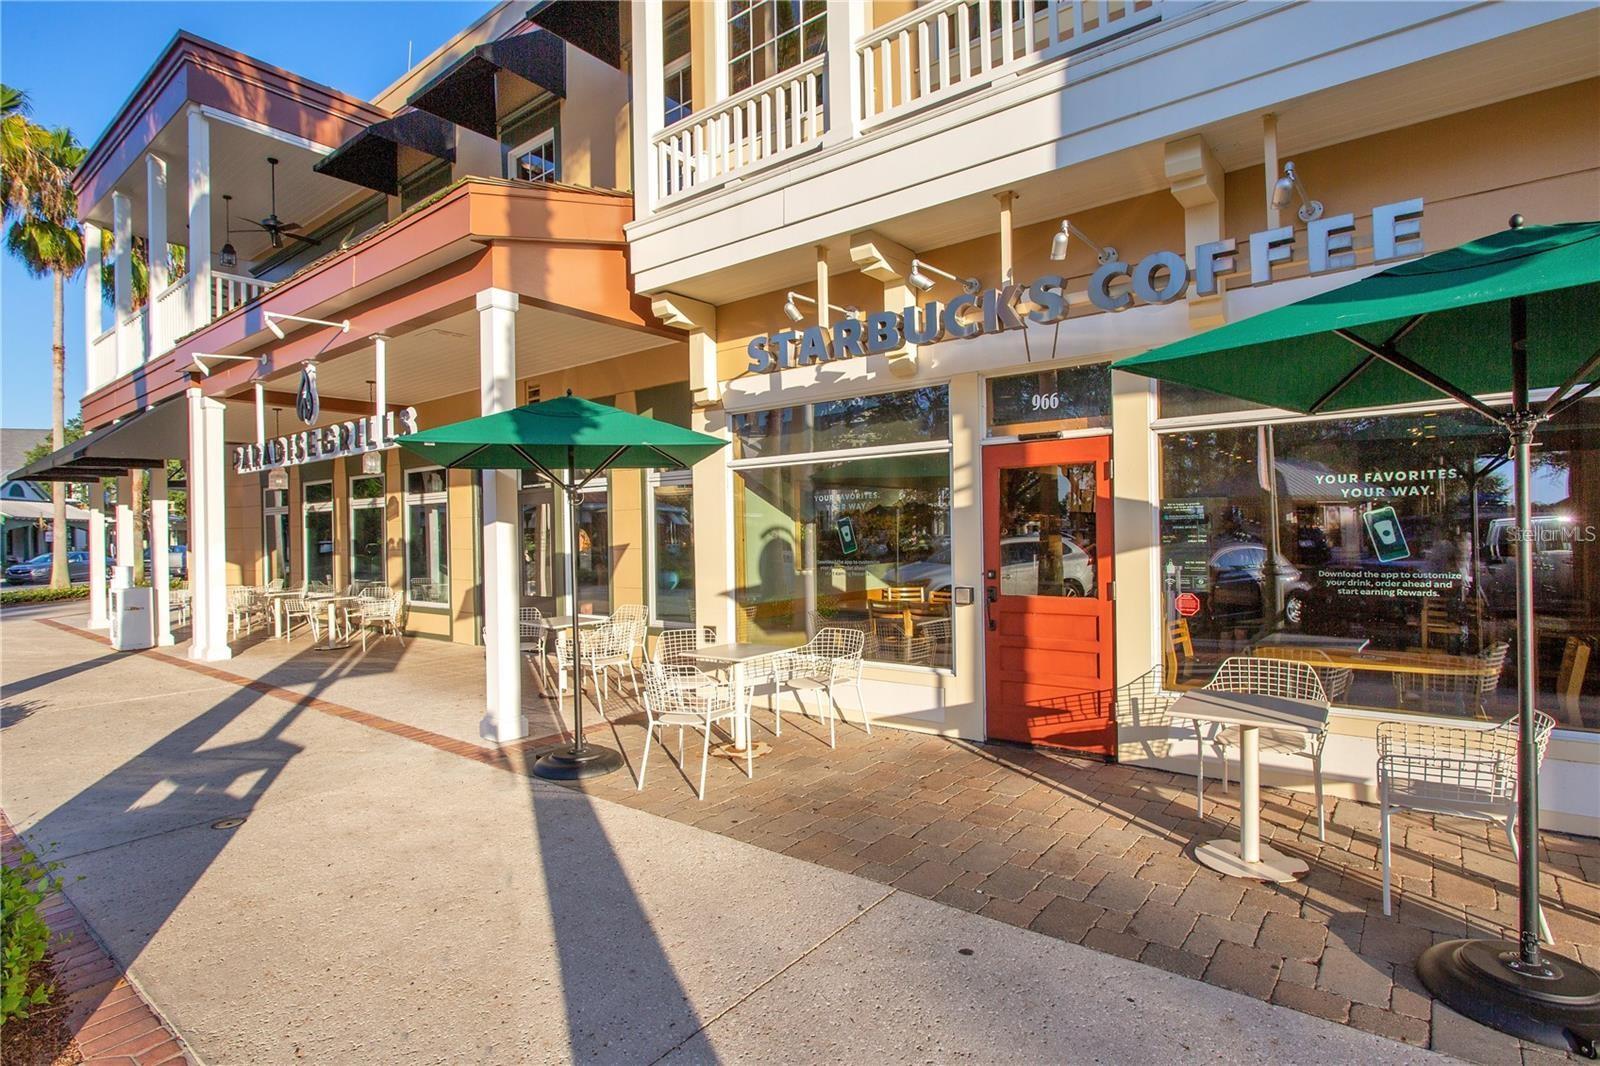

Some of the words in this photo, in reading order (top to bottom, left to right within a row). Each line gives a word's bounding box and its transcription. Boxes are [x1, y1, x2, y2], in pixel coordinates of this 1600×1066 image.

[747, 275, 1069, 375] STARBUCKS
[1087, 197, 1425, 312] COFFEE
[1031, 392, 1060, 411] 966
[1315, 474, 1358, 485] YOUR
[1364, 468, 1464, 483] FAVORITES.
[1341, 486, 1385, 498] YOUR
[1391, 485, 1435, 497] WAY.
[1318, 570, 1362, 578] Download
[1363, 570, 1380, 578] the
[1380, 572, 1399, 581] app
[1412, 571, 1462, 580] customize
[1347, 579, 1374, 588] drink,
[1402, 580, 1432, 588] ahead
[1433, 580, 1453, 588] and
[1360, 588, 1395, 597] earning
[1396, 588, 1441, 597] Rewards.
